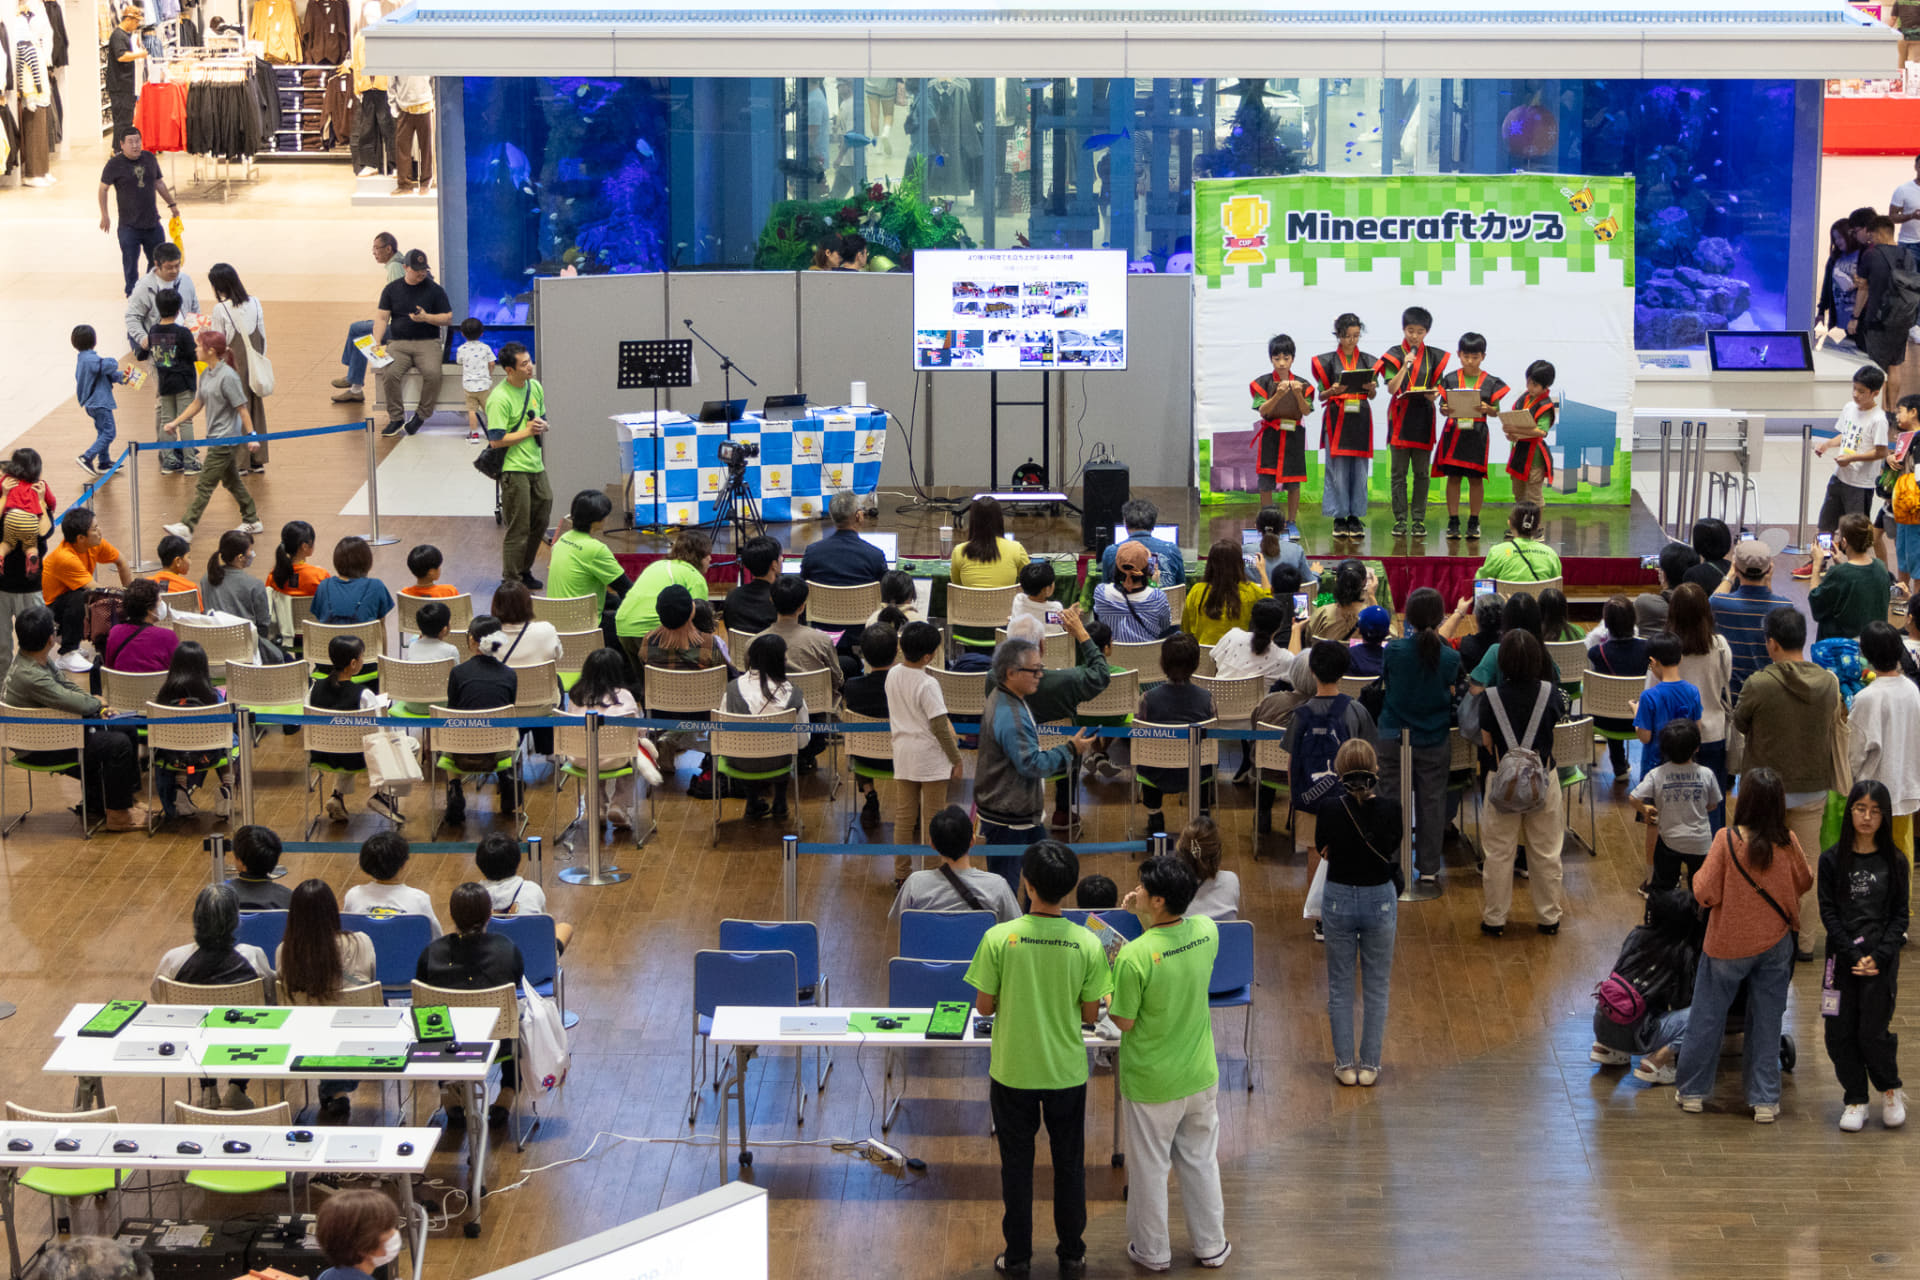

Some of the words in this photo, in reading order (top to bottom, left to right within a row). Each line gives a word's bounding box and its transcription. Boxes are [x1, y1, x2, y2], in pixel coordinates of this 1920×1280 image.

[1286, 211, 1564, 241] Minecraftカップ
[354, 717, 379, 726] MALL
[468, 719, 493, 728] MALL
[700, 722, 725, 731] MALL
[814, 724, 840, 733] MALL
[1037, 726, 1062, 735] MALL
[1152, 729, 1177, 738] MALL
